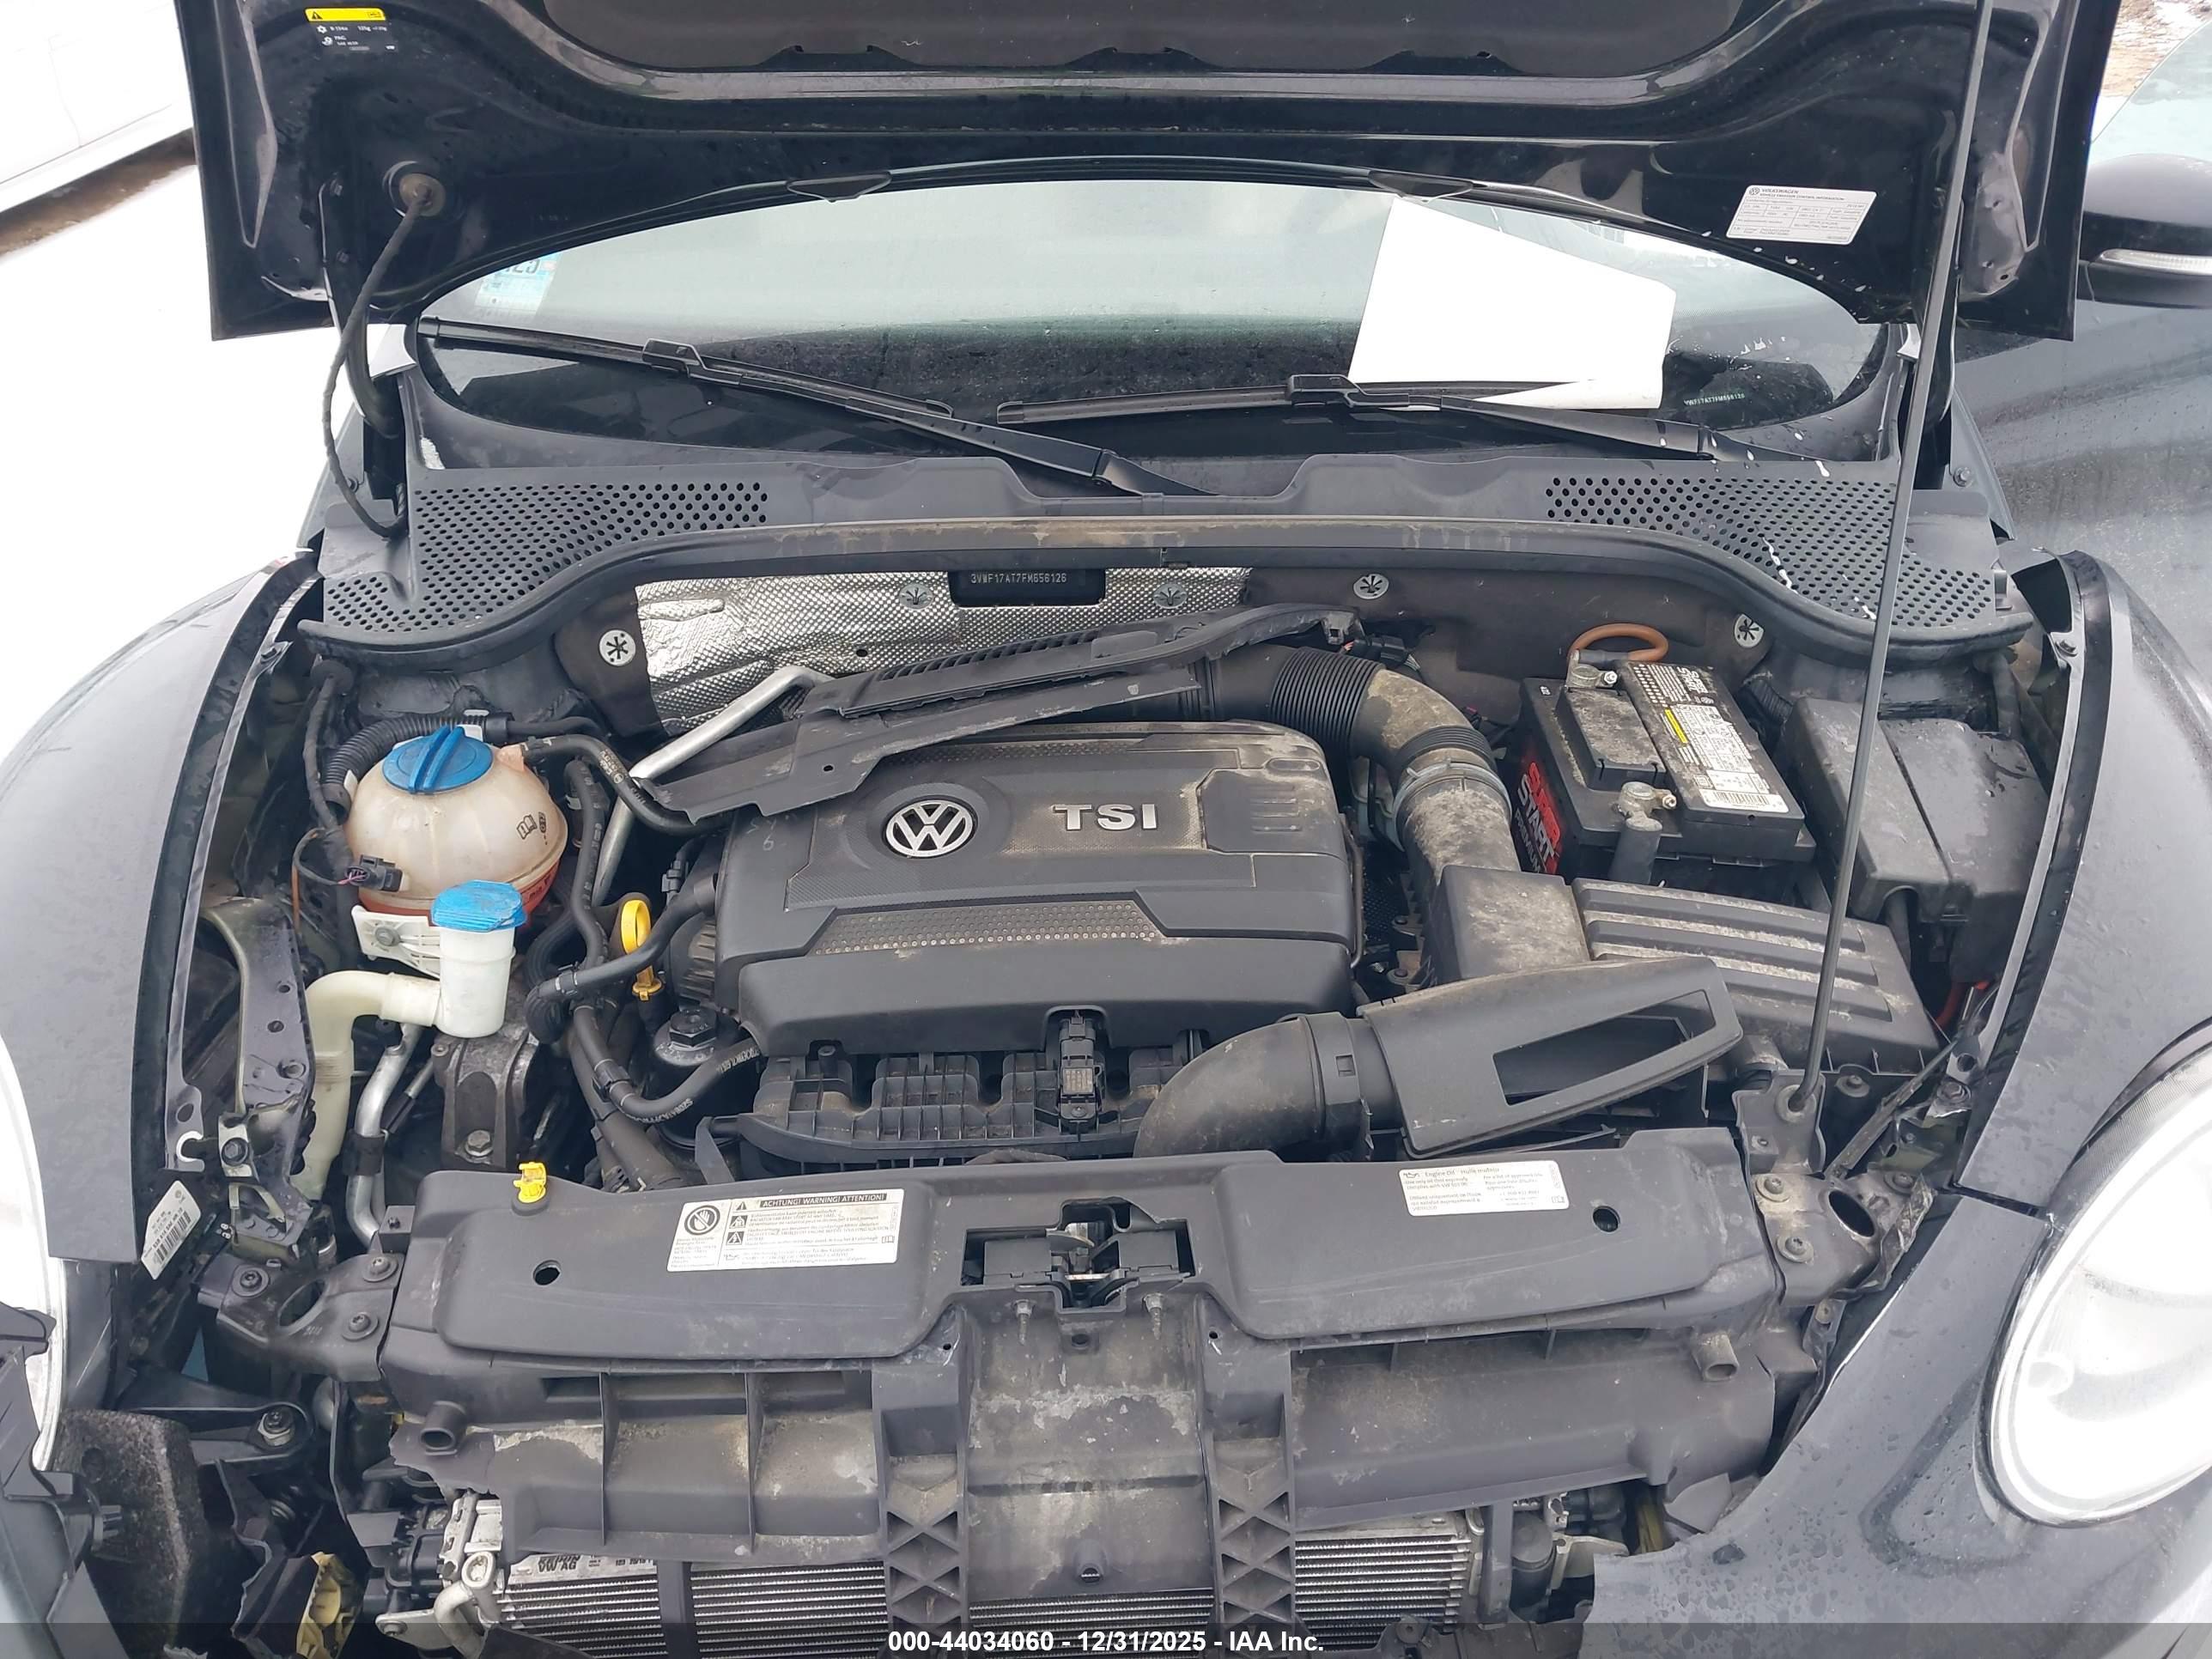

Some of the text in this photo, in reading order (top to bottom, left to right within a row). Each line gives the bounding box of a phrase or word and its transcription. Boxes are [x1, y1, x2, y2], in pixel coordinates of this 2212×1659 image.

[970, 573, 1067, 584] 3VWF17AT7FM656126
[1053, 803, 1158, 831] TSI
[1517, 773, 1555, 862] START
[763, 1193, 885, 1208] ACHTUNG! WARNING! ATTENTION!
